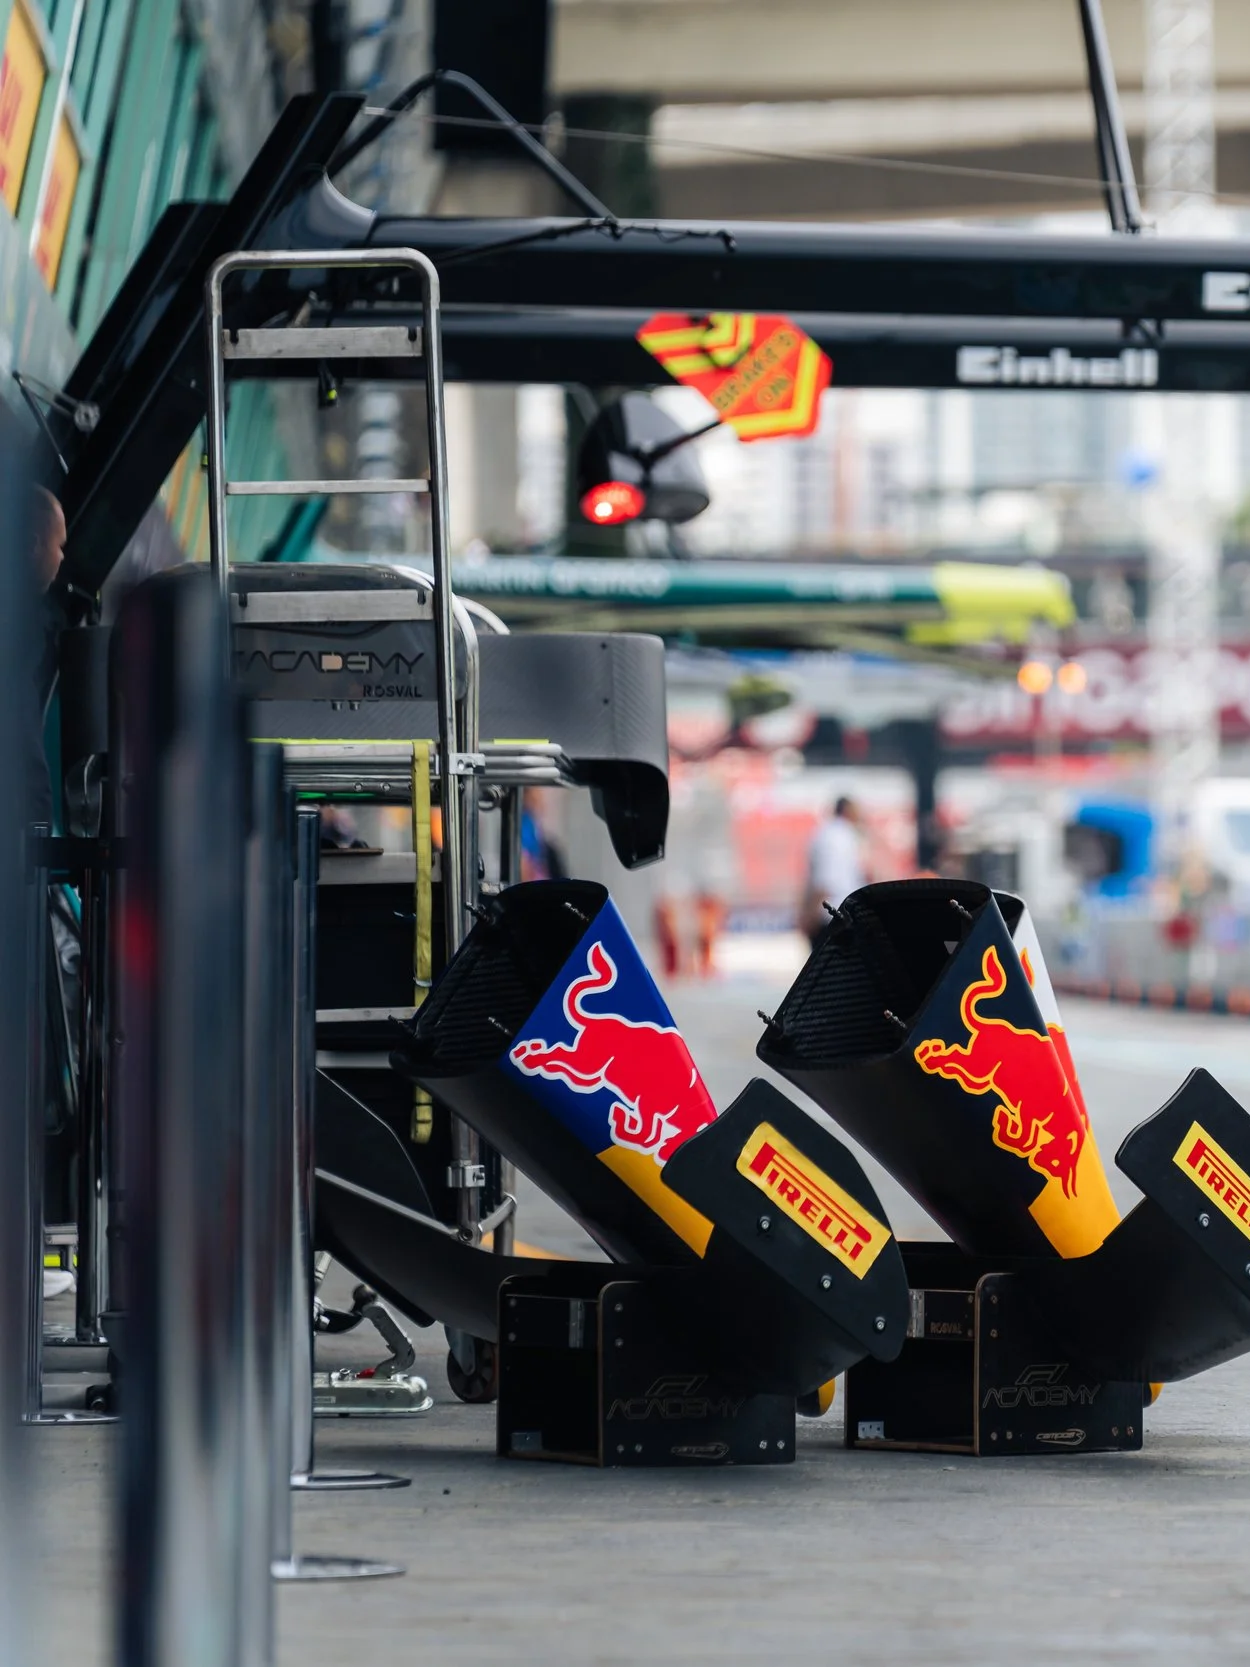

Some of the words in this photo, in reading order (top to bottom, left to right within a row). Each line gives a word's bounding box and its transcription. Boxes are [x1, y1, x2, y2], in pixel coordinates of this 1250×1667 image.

[956, 345, 1158, 386] Einhell
[244, 650, 425, 674] ACADEMY
[362, 684, 423, 698] ROSVAL
[749, 1142, 872, 1261] PIRELLI
[606, 1395, 747, 1421] ACADEMY
[982, 1384, 1101, 1409] ACADEMY
